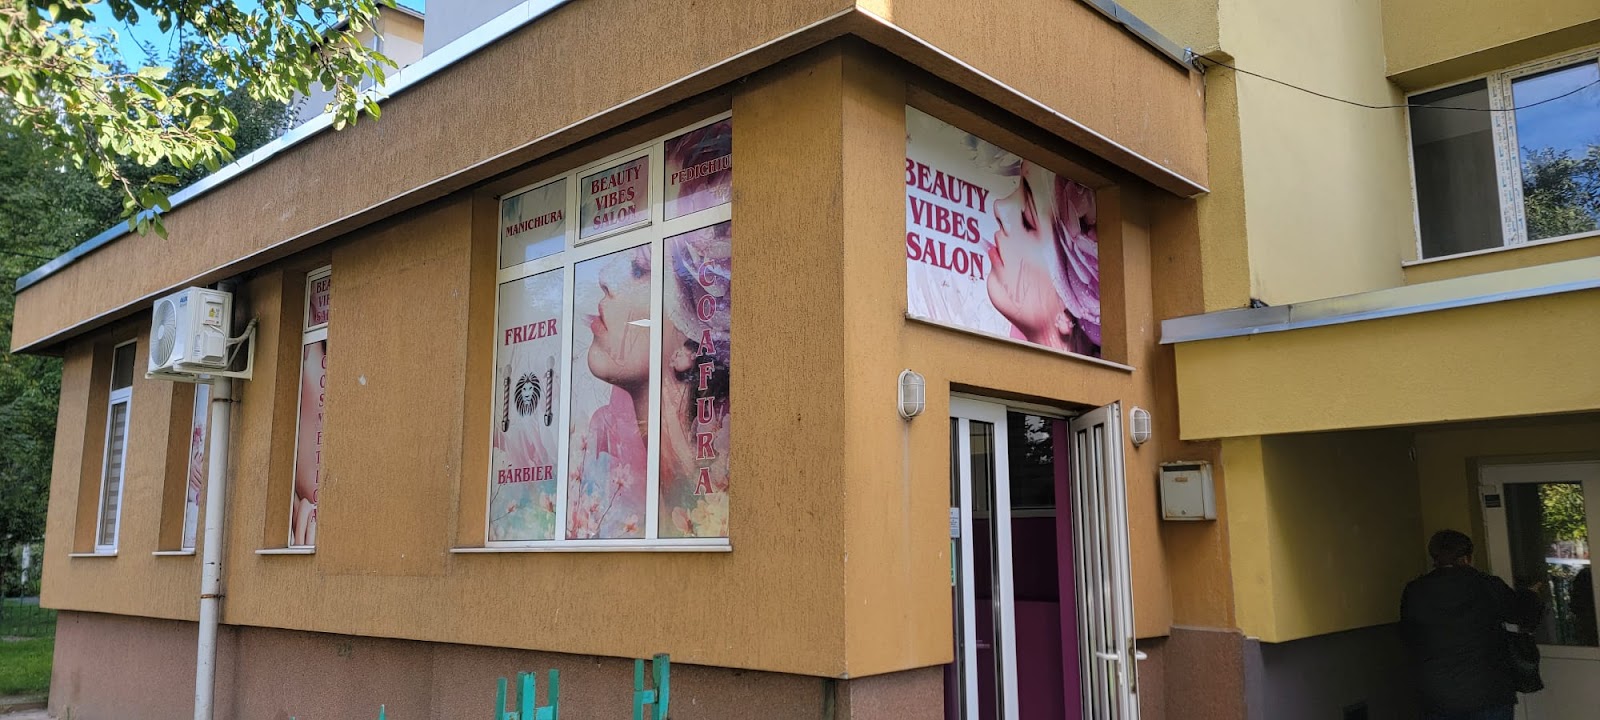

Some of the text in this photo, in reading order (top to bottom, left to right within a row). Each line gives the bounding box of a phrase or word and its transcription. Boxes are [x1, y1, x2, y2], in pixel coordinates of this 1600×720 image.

[591, 164, 642, 195] BEAUTY
[906, 157, 990, 214] BEAUTY
[595, 186, 635, 211] VIBES
[505, 209, 563, 238] MANICHIURA
[593, 204, 636, 230] SALON
[908, 194, 981, 244] VIBES
[906, 231, 985, 281] SALON
[504, 318, 558, 347] FRIZER
[694, 259, 717, 496] COAFURA
